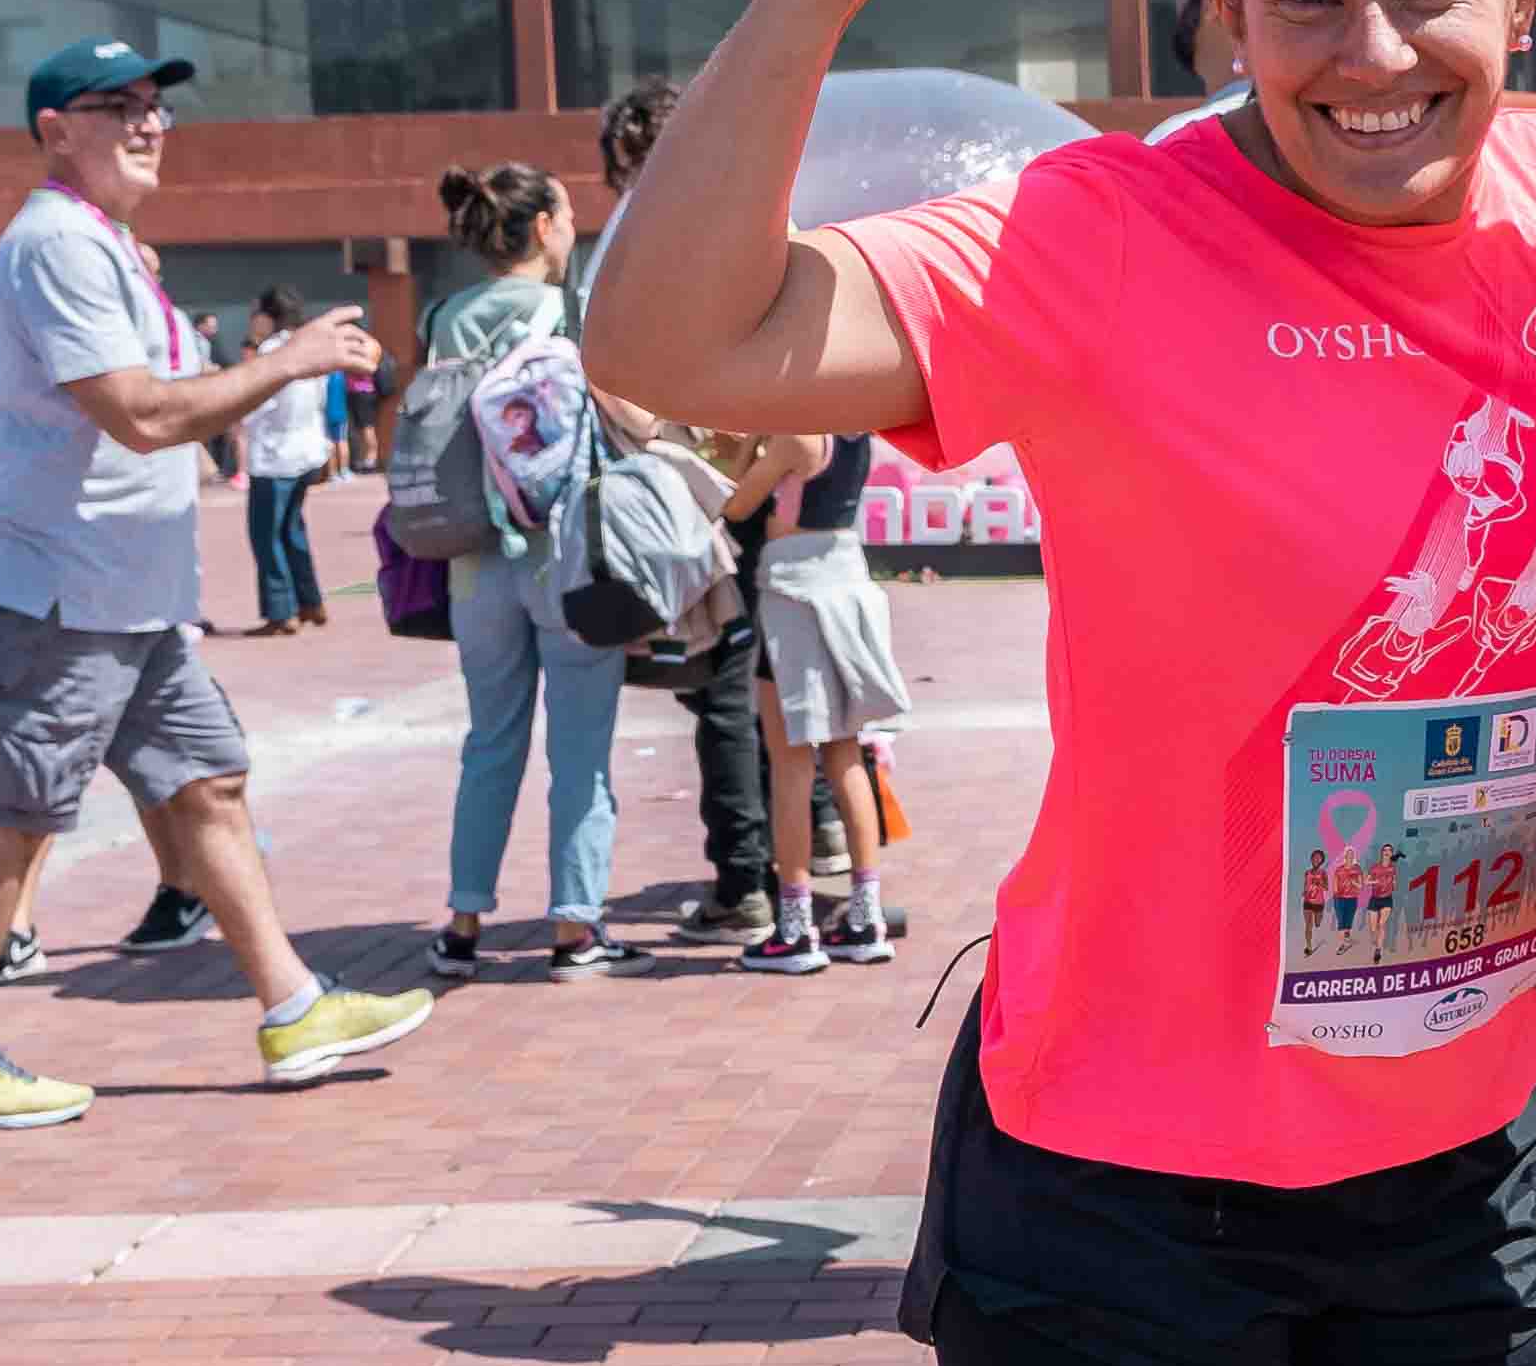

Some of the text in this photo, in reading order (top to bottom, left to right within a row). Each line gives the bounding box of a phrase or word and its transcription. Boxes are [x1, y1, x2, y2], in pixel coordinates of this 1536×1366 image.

[1311, 762, 1377, 782] SUMA
[1408, 850, 1524, 919] 112
[1445, 924, 1485, 954] 658
[1292, 976, 1377, 1000] CARRERA
[1385, 974, 1406, 992] DE
[1410, 971, 1431, 989] LA
[1436, 956, 1483, 984] MUJER
[1495, 944, 1529, 968] GRAN
[1311, 1022, 1384, 1040] OYSHO
